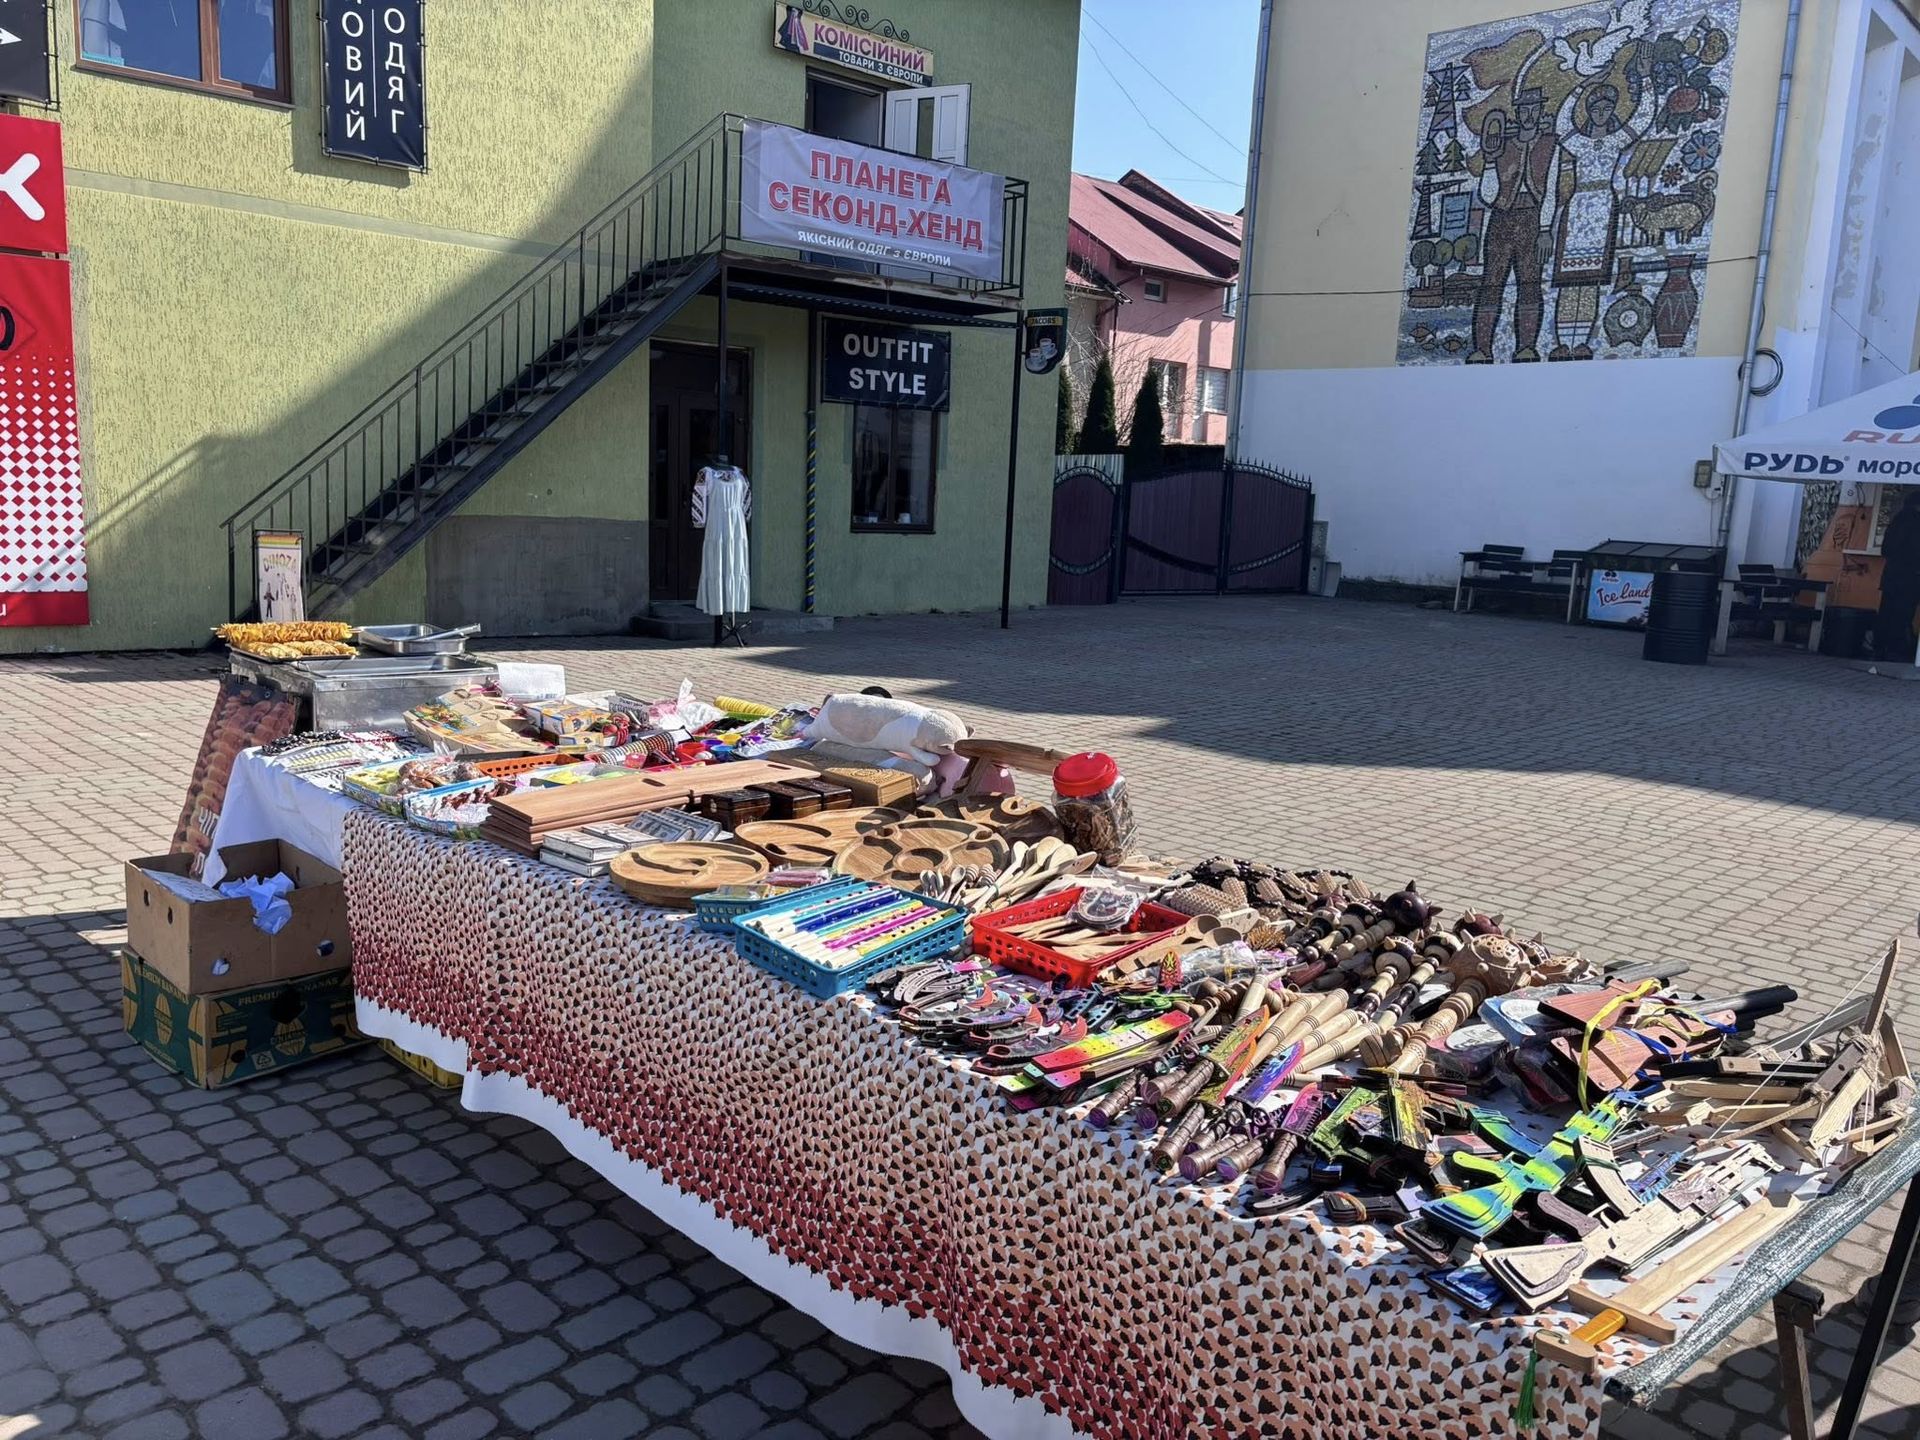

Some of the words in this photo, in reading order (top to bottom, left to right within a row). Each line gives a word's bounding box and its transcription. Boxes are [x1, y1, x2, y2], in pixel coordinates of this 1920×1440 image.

[341, 0, 366, 141] ОВИЙ
[383, 7, 406, 134] ОДЯГ
[814, 22, 925, 72] КОМІСІЙНИЙ
[838, 51, 875, 71] ТОВАРИ
[887, 67, 924, 84] ЄВРОПИ
[810, 149, 953, 206] ПЛАНЕТА
[768, 181, 984, 254] СЕКОНД-ХЕНД
[797, 230, 855, 251] ЯКІСНИЙ
[857, 242, 891, 257] ОДЯГ
[903, 248, 952, 267] ЄВРОПИ
[843, 333, 933, 364] OUTFIT
[849, 367, 927, 395] STYLE
